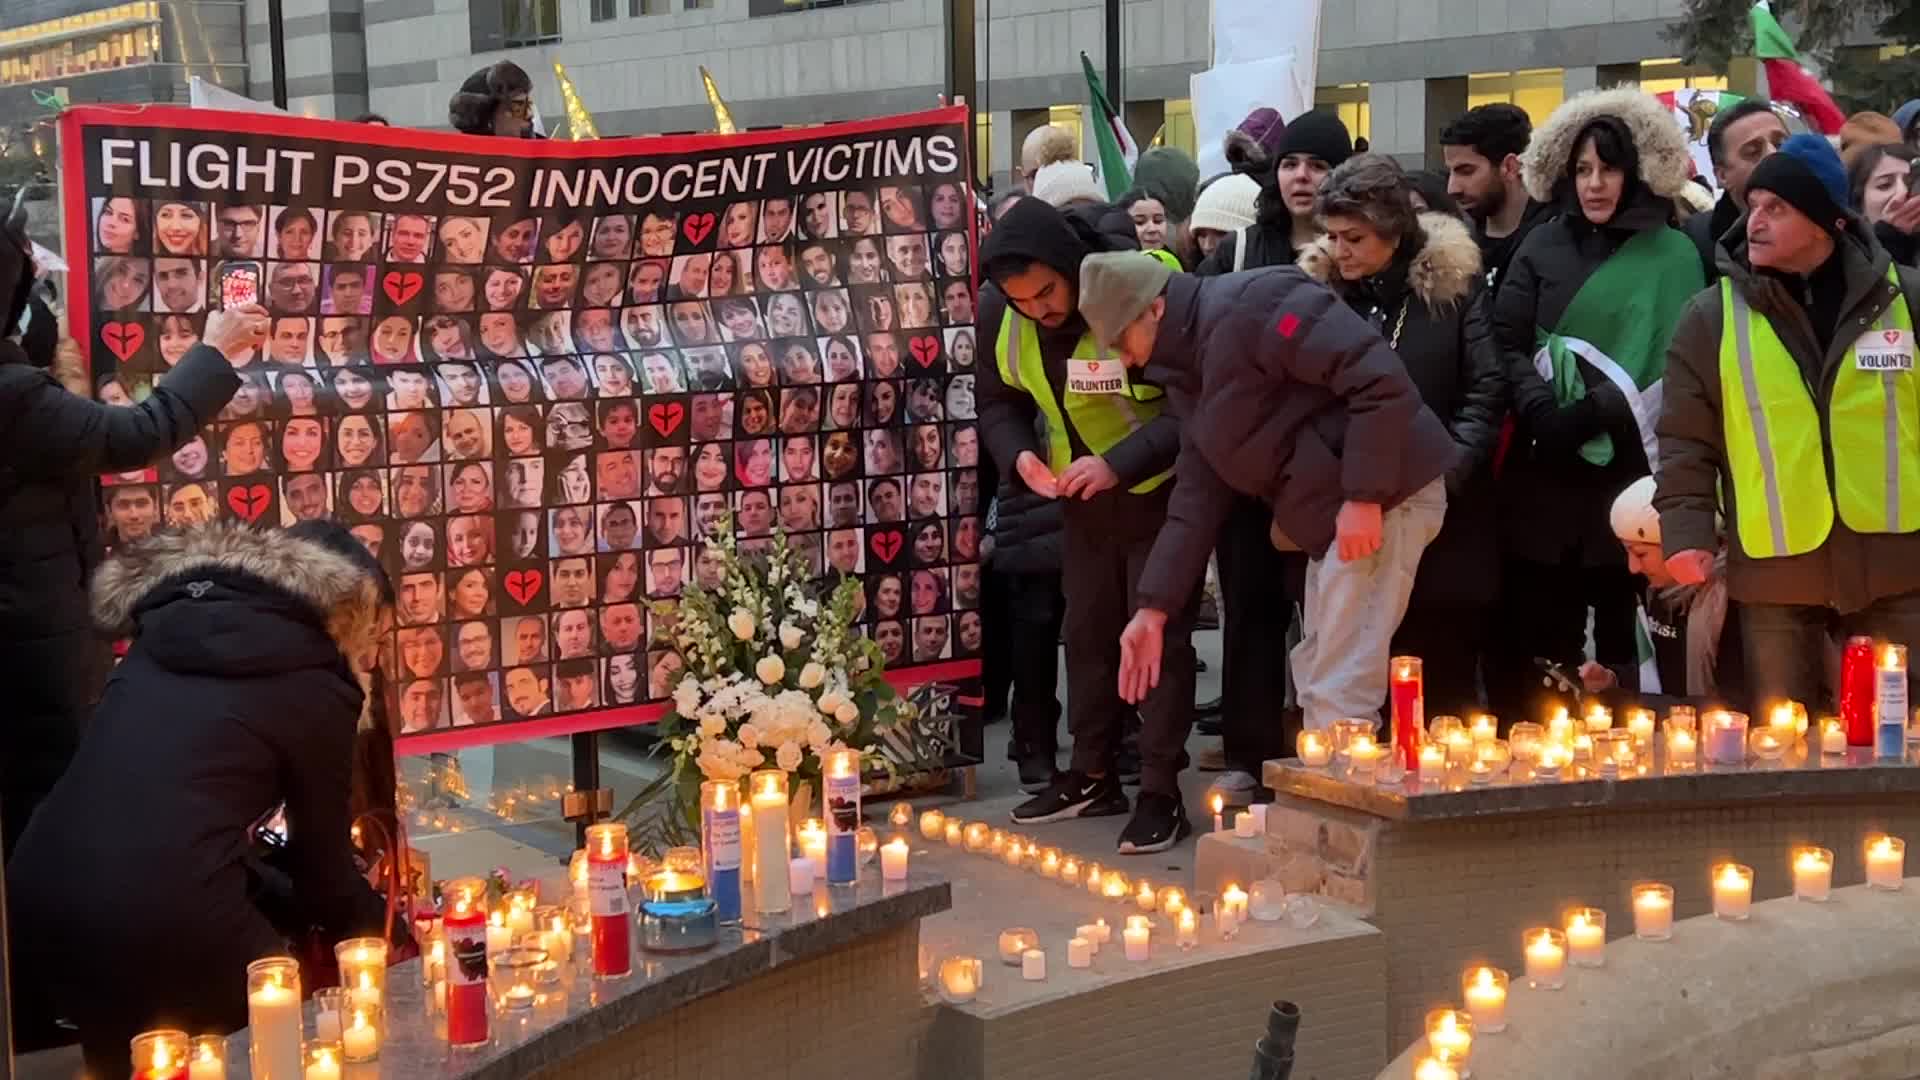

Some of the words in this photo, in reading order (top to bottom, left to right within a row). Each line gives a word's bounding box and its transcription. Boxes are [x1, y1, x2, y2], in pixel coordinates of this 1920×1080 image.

[101, 138, 315, 195] FLIGHT
[332, 154, 516, 207] PS752
[529, 152, 777, 208] INNOCENT
[786, 135, 958, 186] VICTIMS
[1070, 378, 1122, 391] VOLUNTEER
